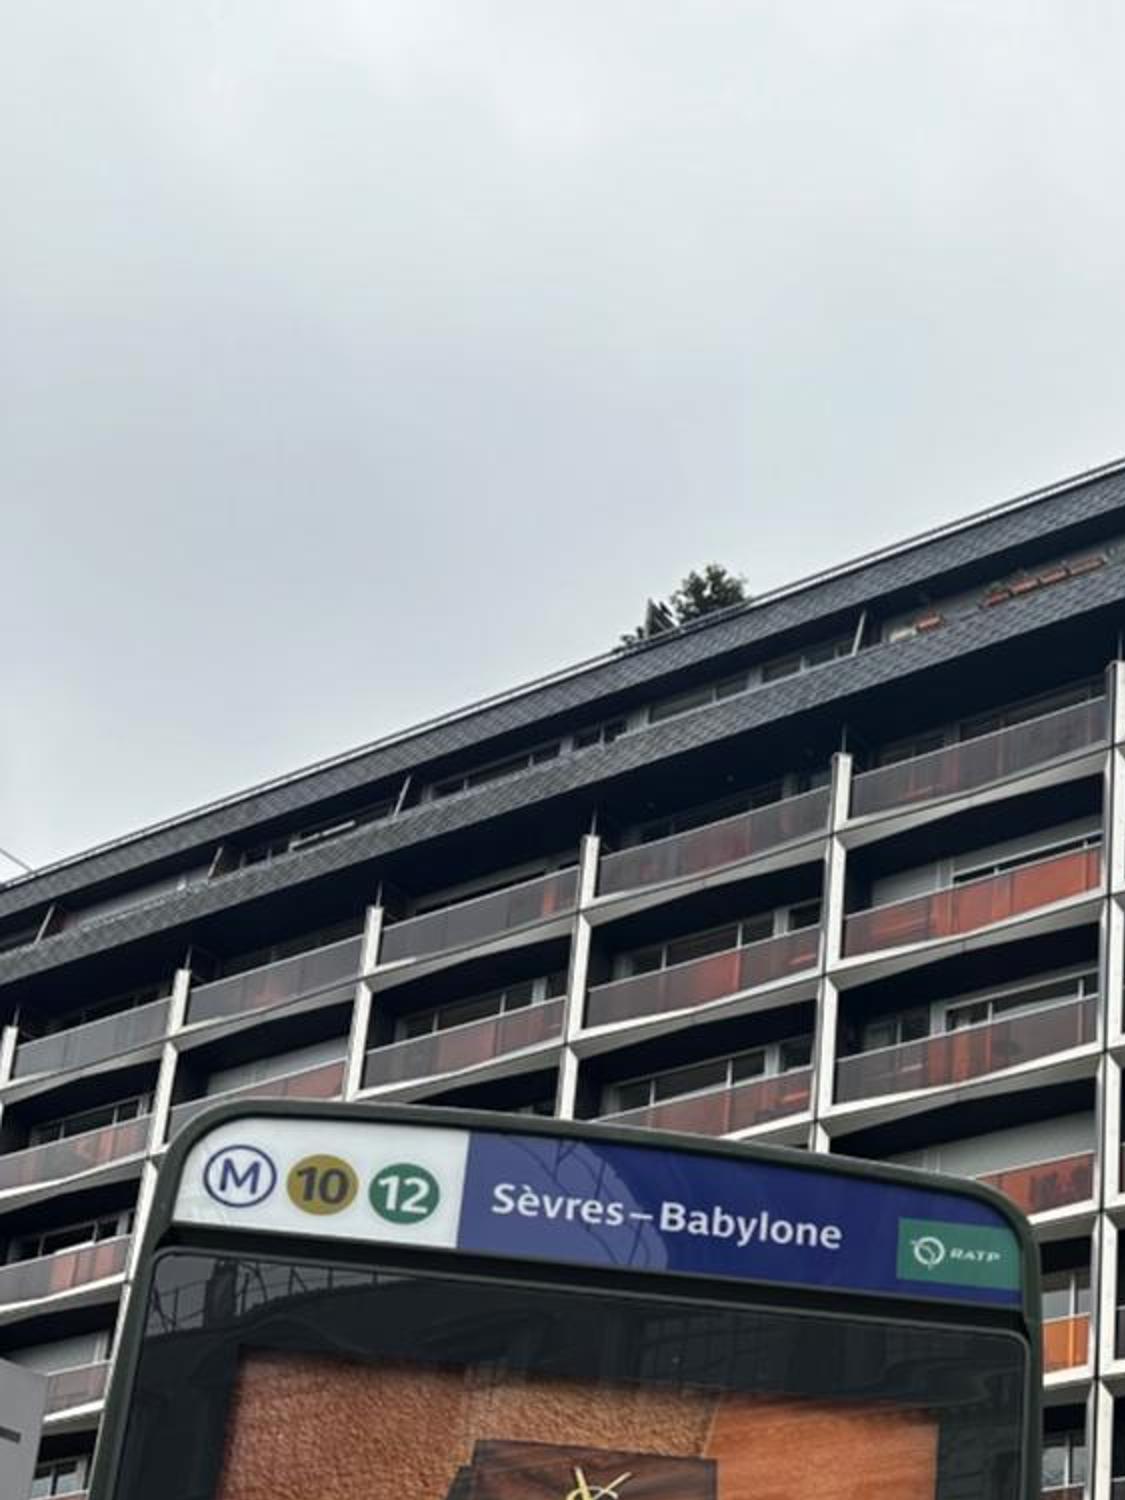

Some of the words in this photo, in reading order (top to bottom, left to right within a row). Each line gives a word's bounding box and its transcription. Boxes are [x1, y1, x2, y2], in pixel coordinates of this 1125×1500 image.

[296, 1166, 349, 1205] 10
[378, 1175, 429, 1215] 12
[949, 1247, 1001, 1262] RATP
